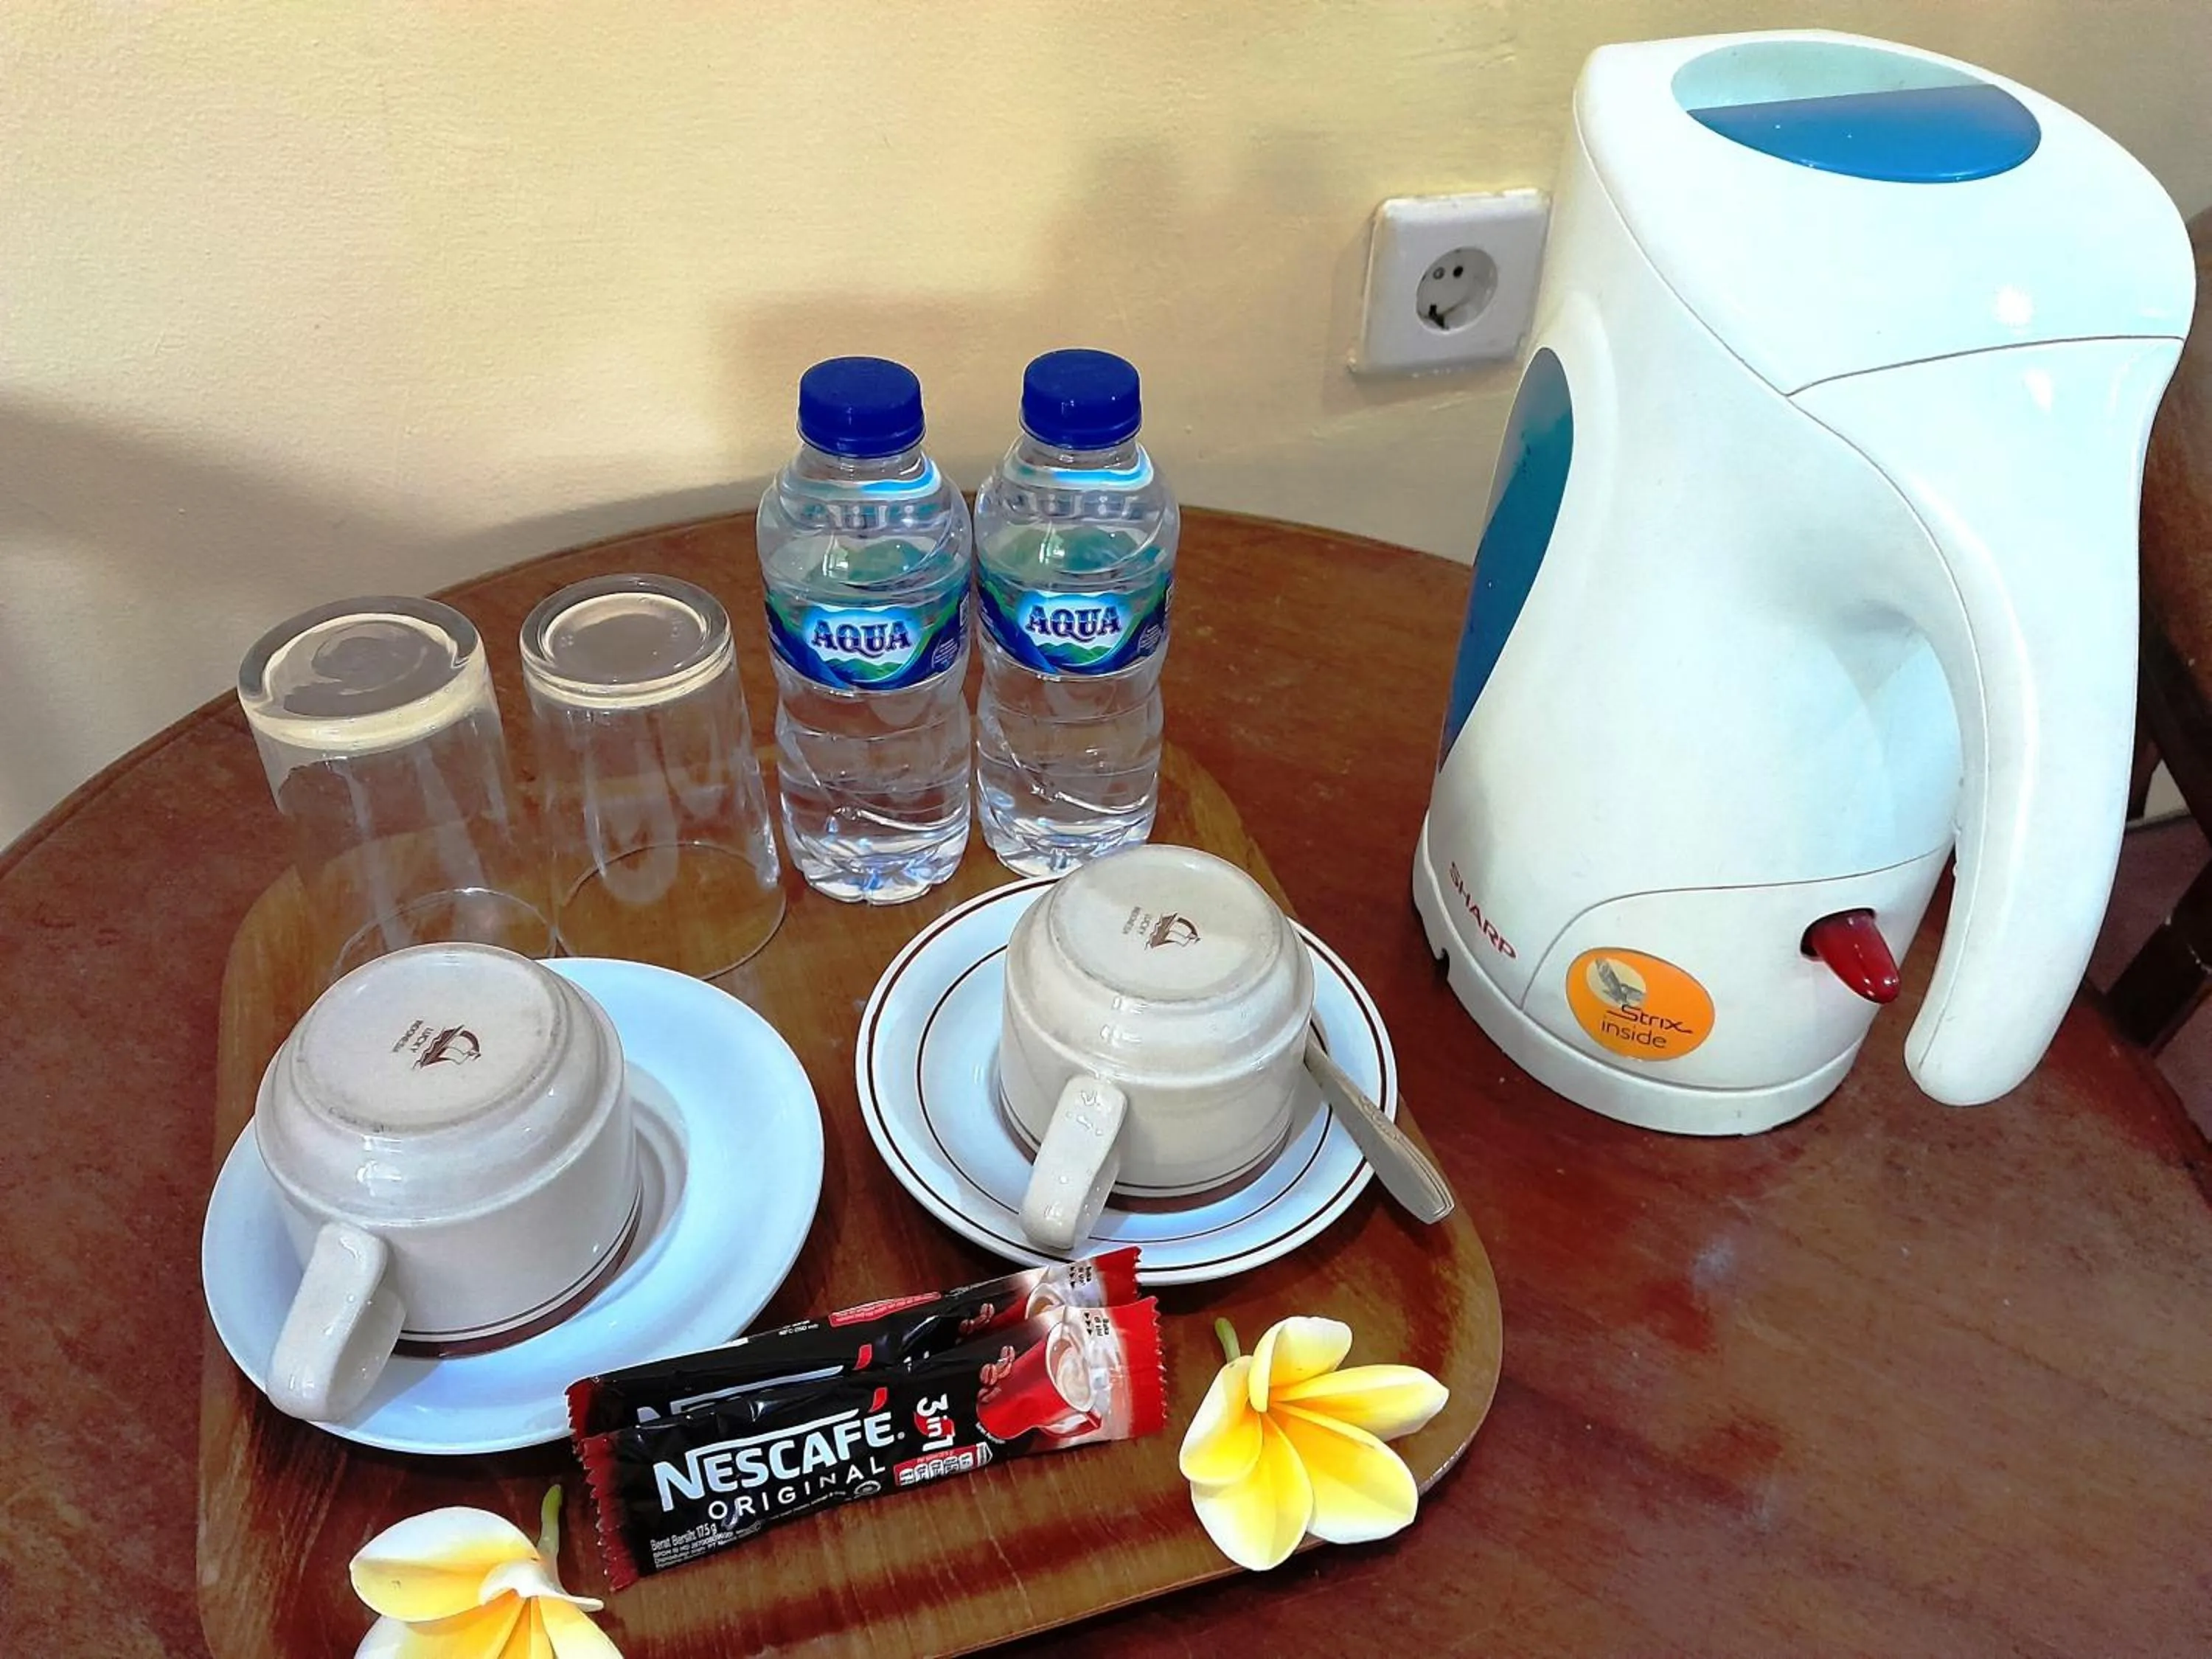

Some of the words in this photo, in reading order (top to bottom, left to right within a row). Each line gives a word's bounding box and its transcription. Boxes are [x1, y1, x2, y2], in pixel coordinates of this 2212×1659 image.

[810, 619, 912, 658] AQUA
[1025, 605, 1121, 643] AQUA
[1448, 861, 1518, 960] SHARP
[1601, 1015, 1667, 1049] inside
[1606, 1004, 1694, 1034] Strix
[709, 1455, 886, 1519] ORIGINAL
